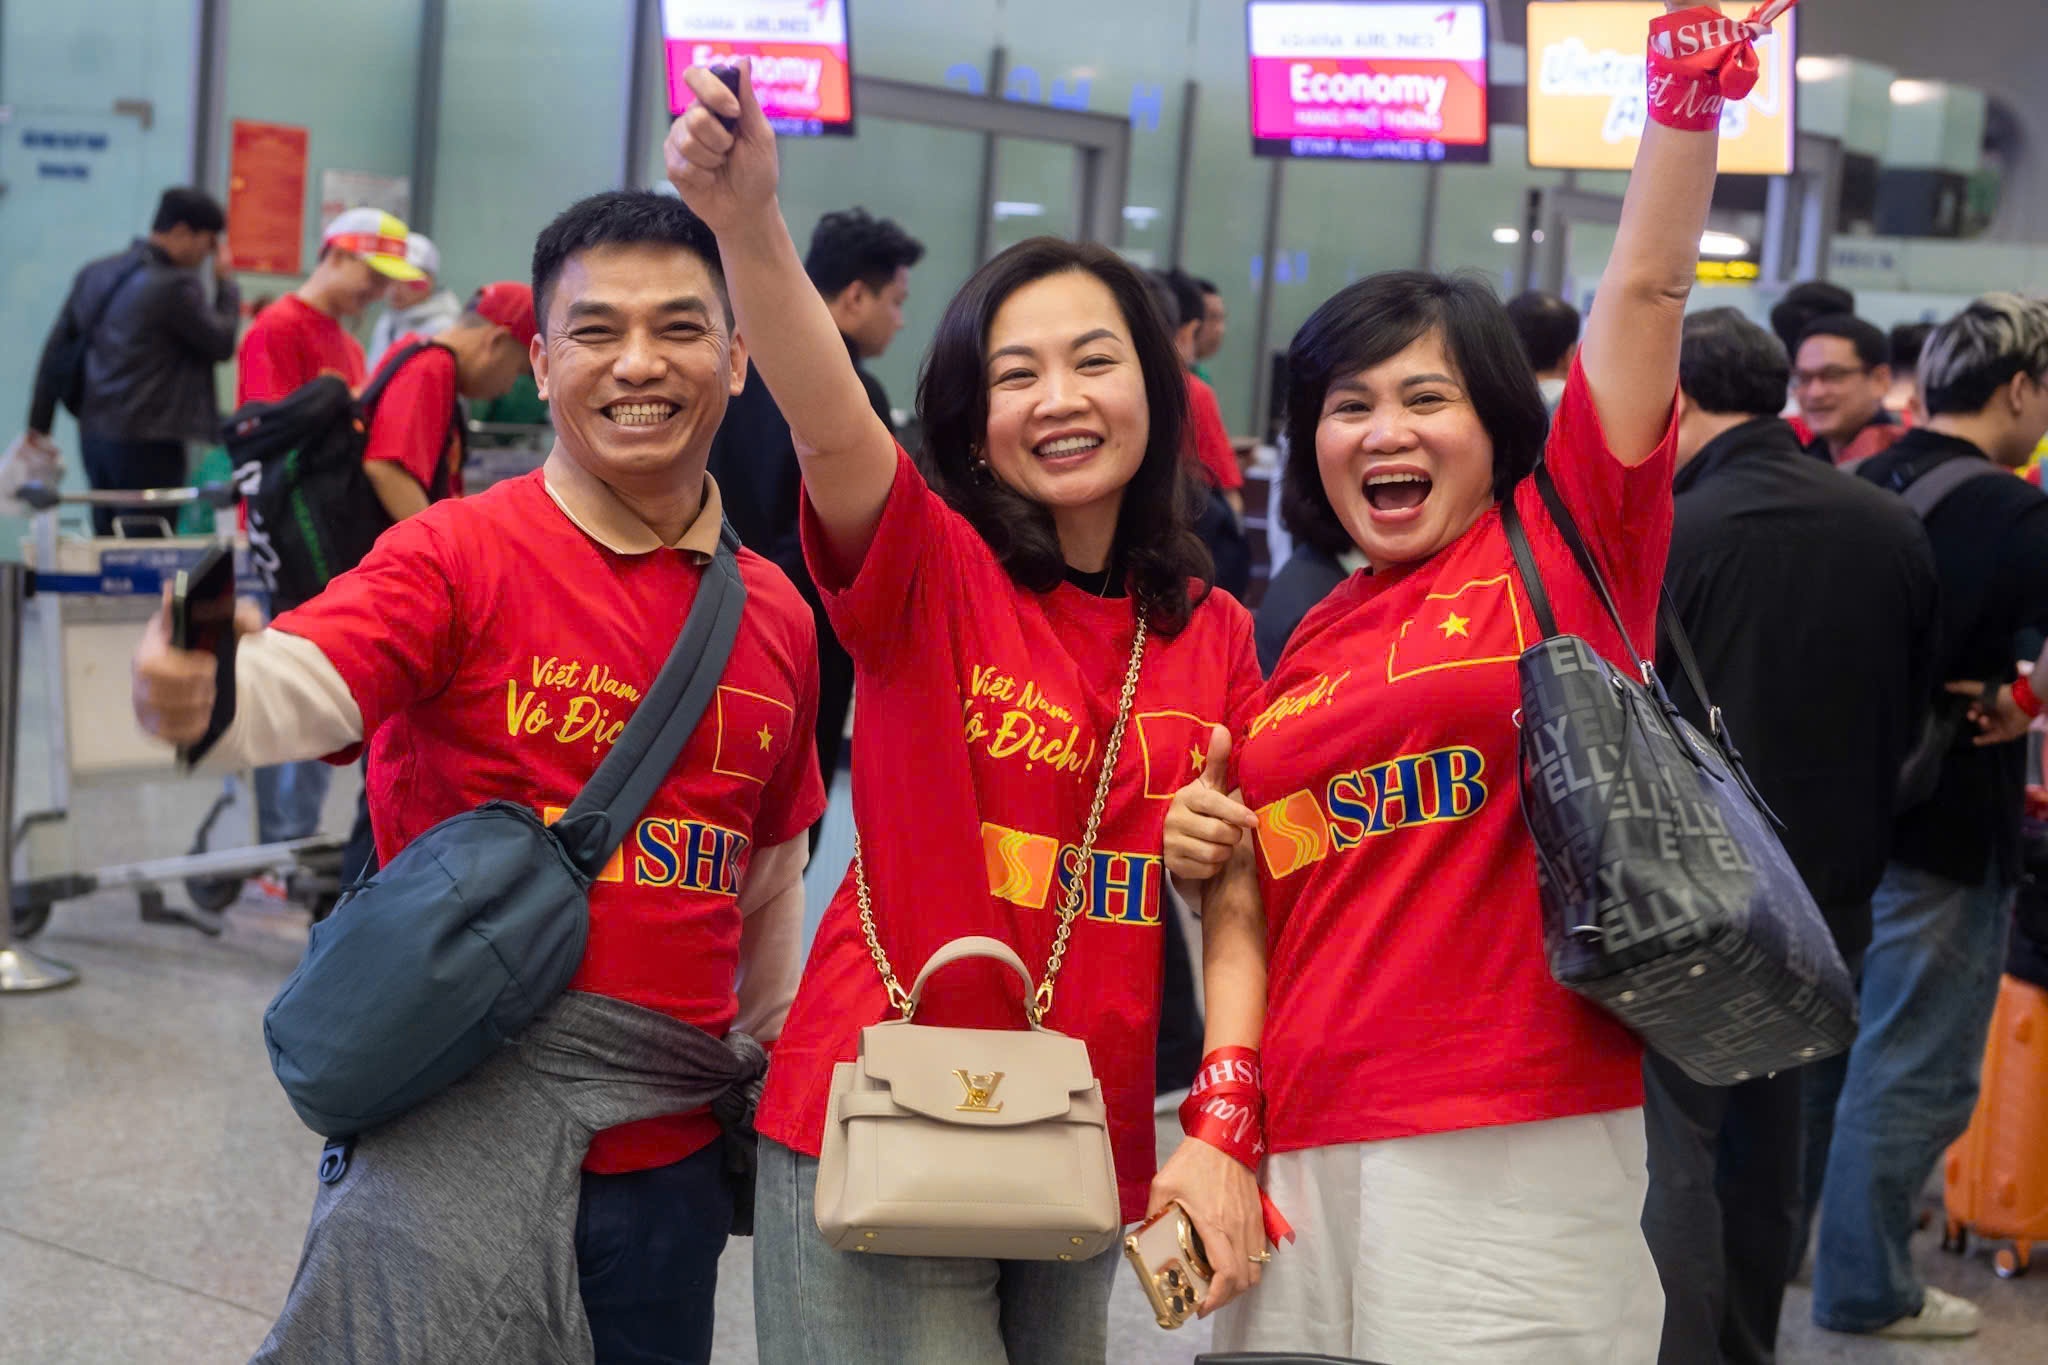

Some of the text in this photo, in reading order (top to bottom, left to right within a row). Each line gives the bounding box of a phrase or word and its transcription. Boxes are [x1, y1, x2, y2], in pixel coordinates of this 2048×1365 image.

[1289, 63, 1448, 116] Economy
[1673, 79, 1723, 119] Na
[532, 655, 641, 703] Việt Nam
[1546, 637, 1602, 676] EL
[507, 679, 627, 753] Vô Địc
[972, 664, 1073, 723] Việt Nam
[987, 711, 1097, 783] Địch!
[1327, 744, 1489, 853] SHB
[1055, 843, 1163, 926] SH
[1602, 889, 1703, 954] ELLY
[952, 1069, 1005, 1113] LV
